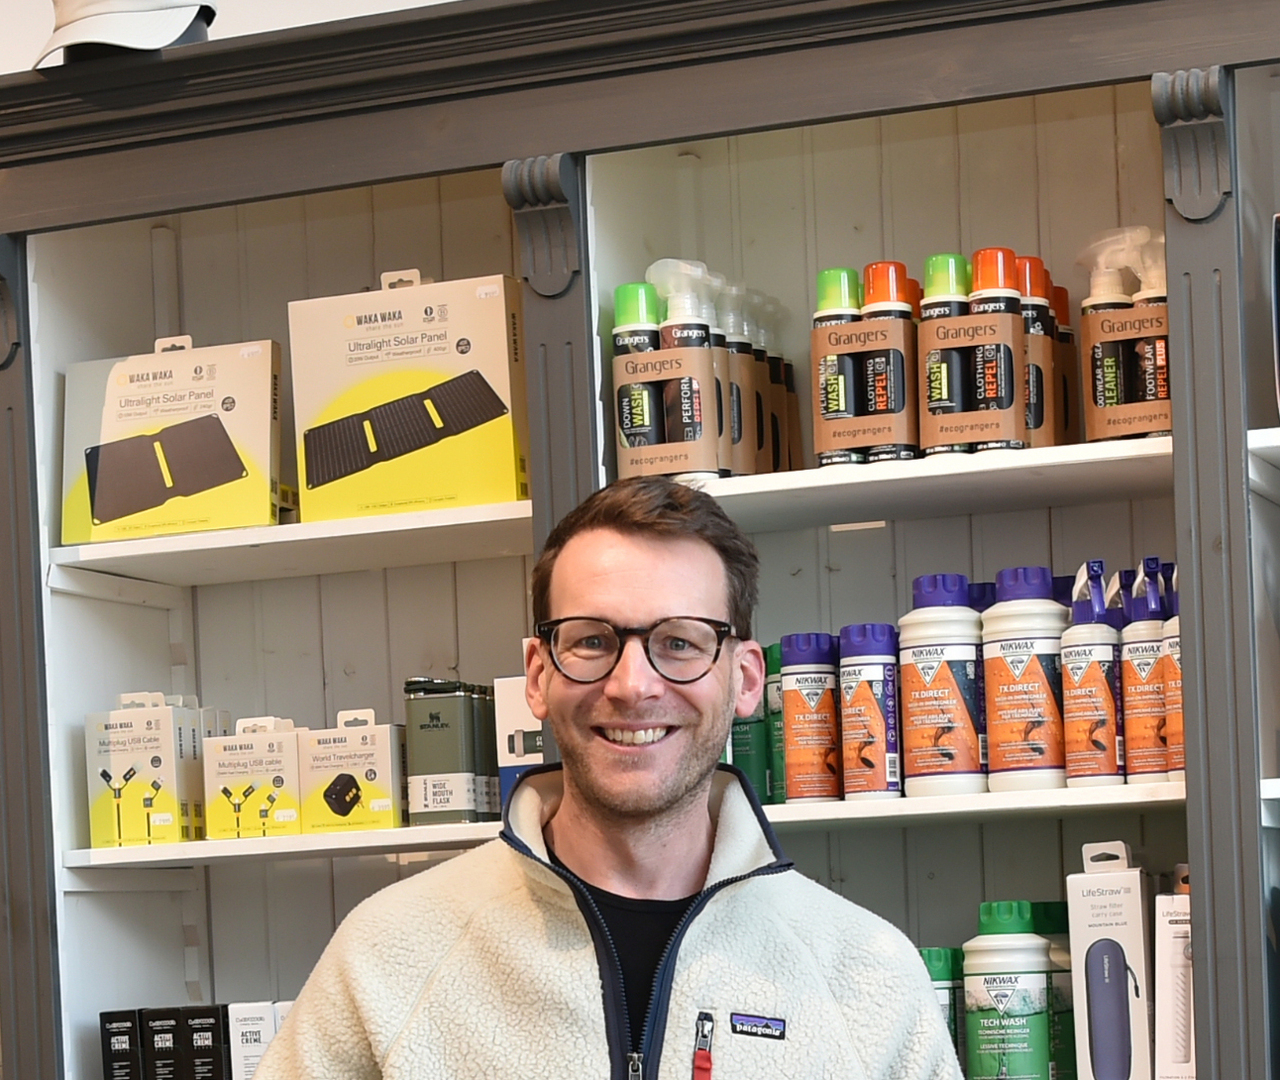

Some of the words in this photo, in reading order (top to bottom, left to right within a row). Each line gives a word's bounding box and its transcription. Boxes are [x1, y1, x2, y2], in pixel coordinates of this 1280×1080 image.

[672, 329, 706, 339] Grangers
[936, 325, 997, 341] Grangers
[1100, 318, 1164, 334] Grangers
[348, 337, 392, 352] Ultralight
[394, 335, 418, 347] Solar
[421, 331, 447, 343] Panel
[616, 335, 649, 347] Grangers
[828, 329, 888, 347] Grangers
[625, 358, 683, 376] Grangers
[1146, 344, 1155, 400] FOOTWEAR
[931, 363, 941, 401] WASH
[985, 360, 997, 398] REPEL
[1157, 366, 1167, 398] REPEL
[119, 395, 161, 408] Ultralight
[162, 393, 186, 403] Solar
[188, 389, 214, 400] Panel
[827, 375, 838, 413] WASH
[876, 373, 887, 410] REPEL
[633, 391, 642, 427] WASH
[912, 648, 945, 658] NIKWAX
[1000, 641, 1035, 651] NIKWAX
[312, 754, 330, 763] World
[332, 752, 375, 763] Travelcharger
[983, 976, 1019, 986] NIKWAX
[736, 1023, 781, 1036] patagonia
[980, 1018, 998, 1027] TECH
[1000, 1017, 1026, 1026] WASH
[240, 1030, 261, 1038] ACTIVE
